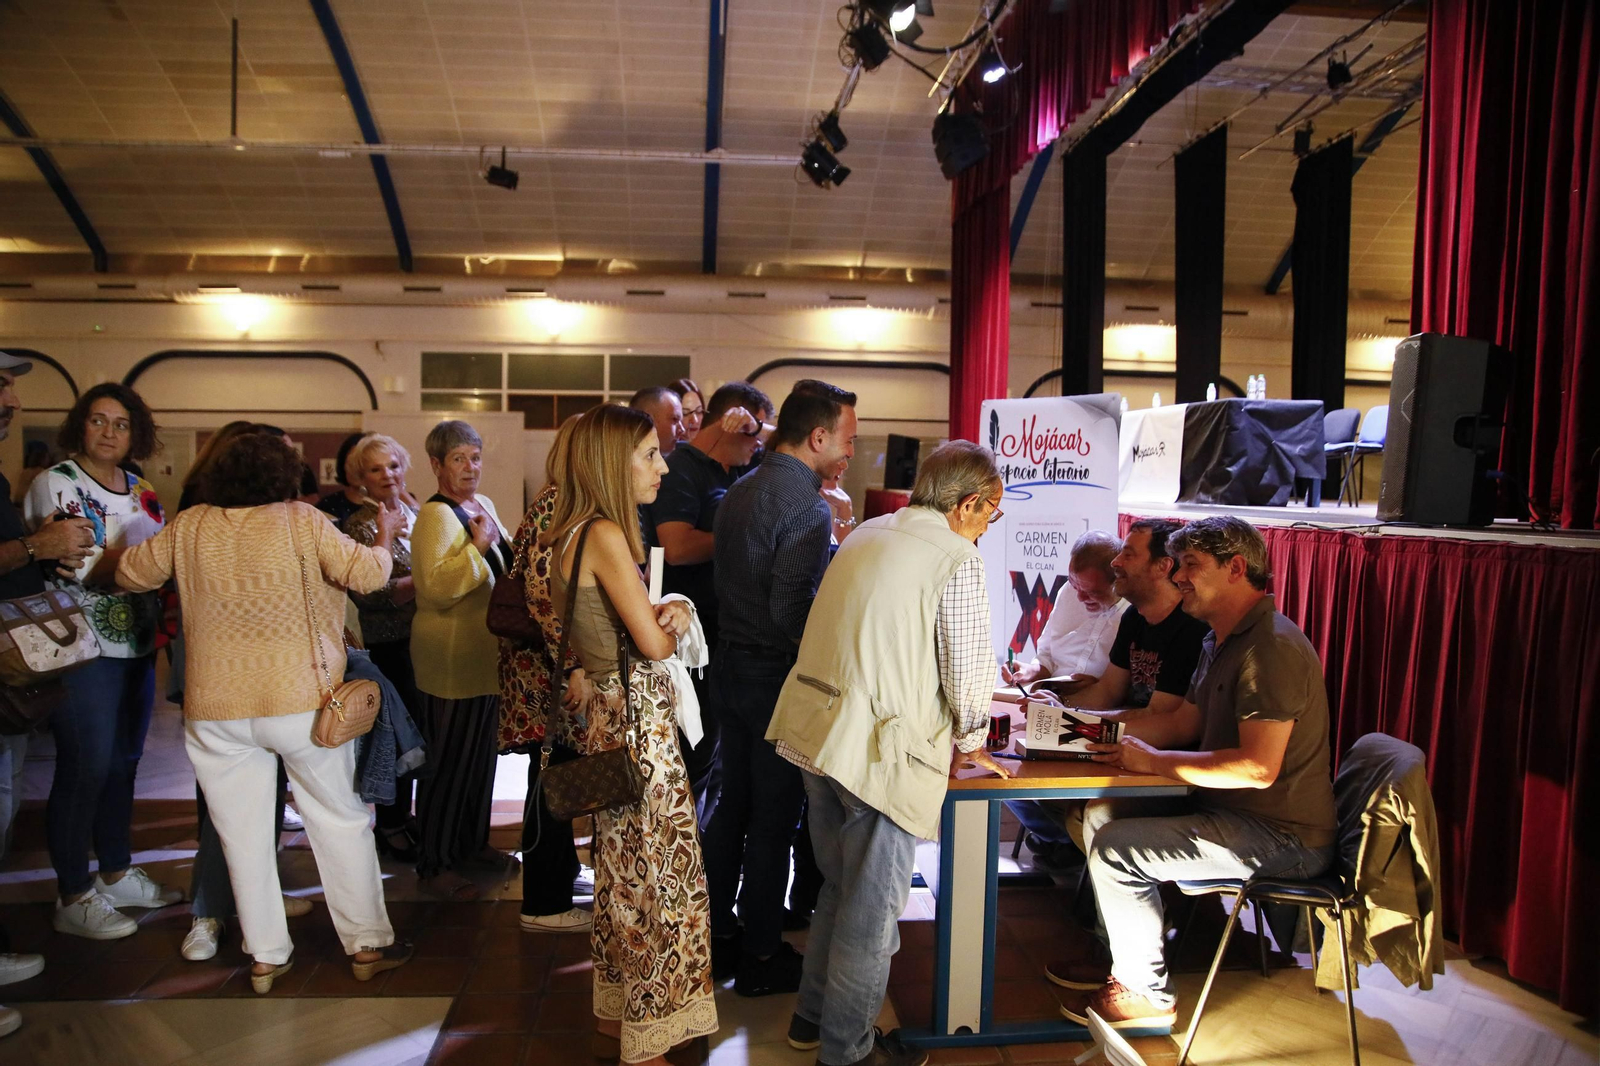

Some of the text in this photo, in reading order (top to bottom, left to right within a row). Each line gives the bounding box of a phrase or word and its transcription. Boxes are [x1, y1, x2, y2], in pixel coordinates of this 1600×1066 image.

[1001, 414, 1090, 465] Mojácar
[1000, 457, 1090, 485] spacio literario
[1015, 531, 1067, 544] CARMEN
[1023, 545, 1058, 558] MOLA
[1026, 561, 1055, 571] EL CLAN
[1034, 709, 1045, 741] CARMEN
[1043, 715, 1053, 735] MOLA
